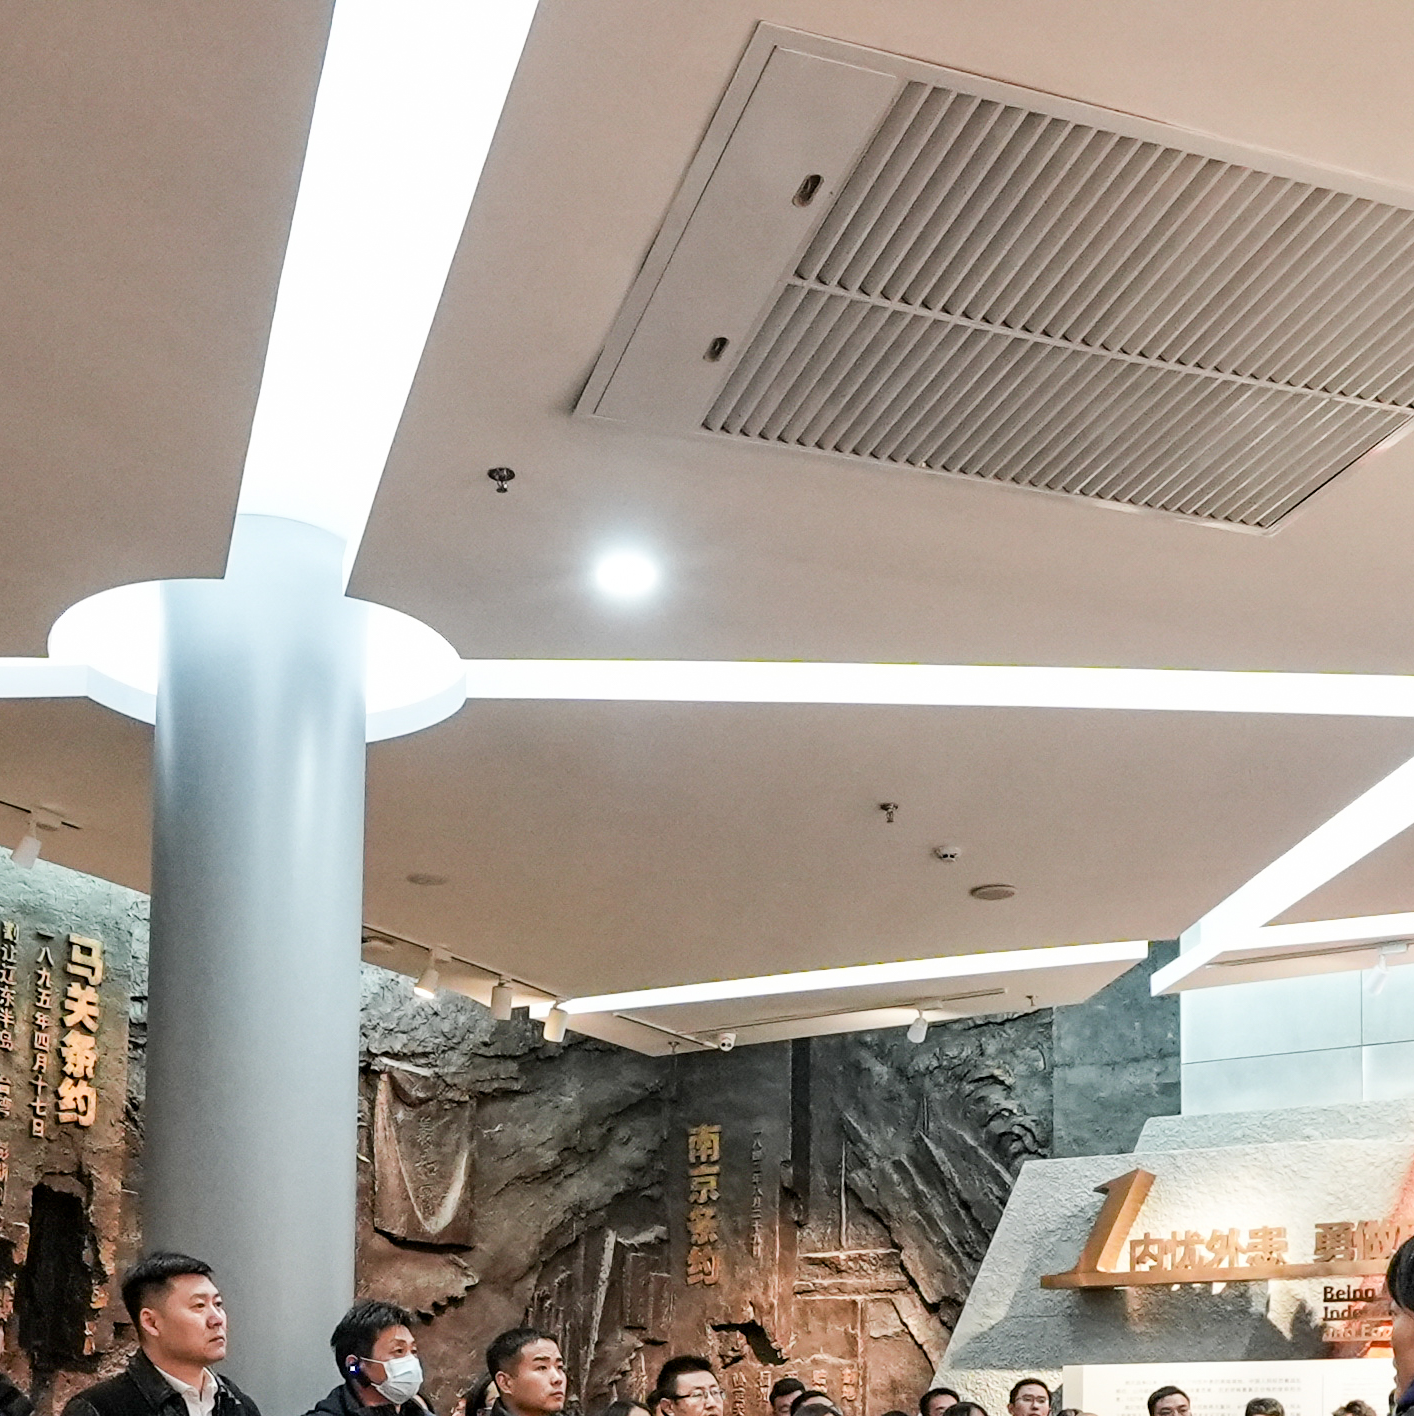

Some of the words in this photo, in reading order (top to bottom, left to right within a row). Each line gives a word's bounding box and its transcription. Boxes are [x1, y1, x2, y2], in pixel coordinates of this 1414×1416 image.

[31, 929, 56, 1139] 一八九五年四月十七日
[57, 932, 106, 1127] 马关条约
[687, 1123, 722, 1286] 南京条约
[1129, 1225, 1288, 1272] 内忧外患
